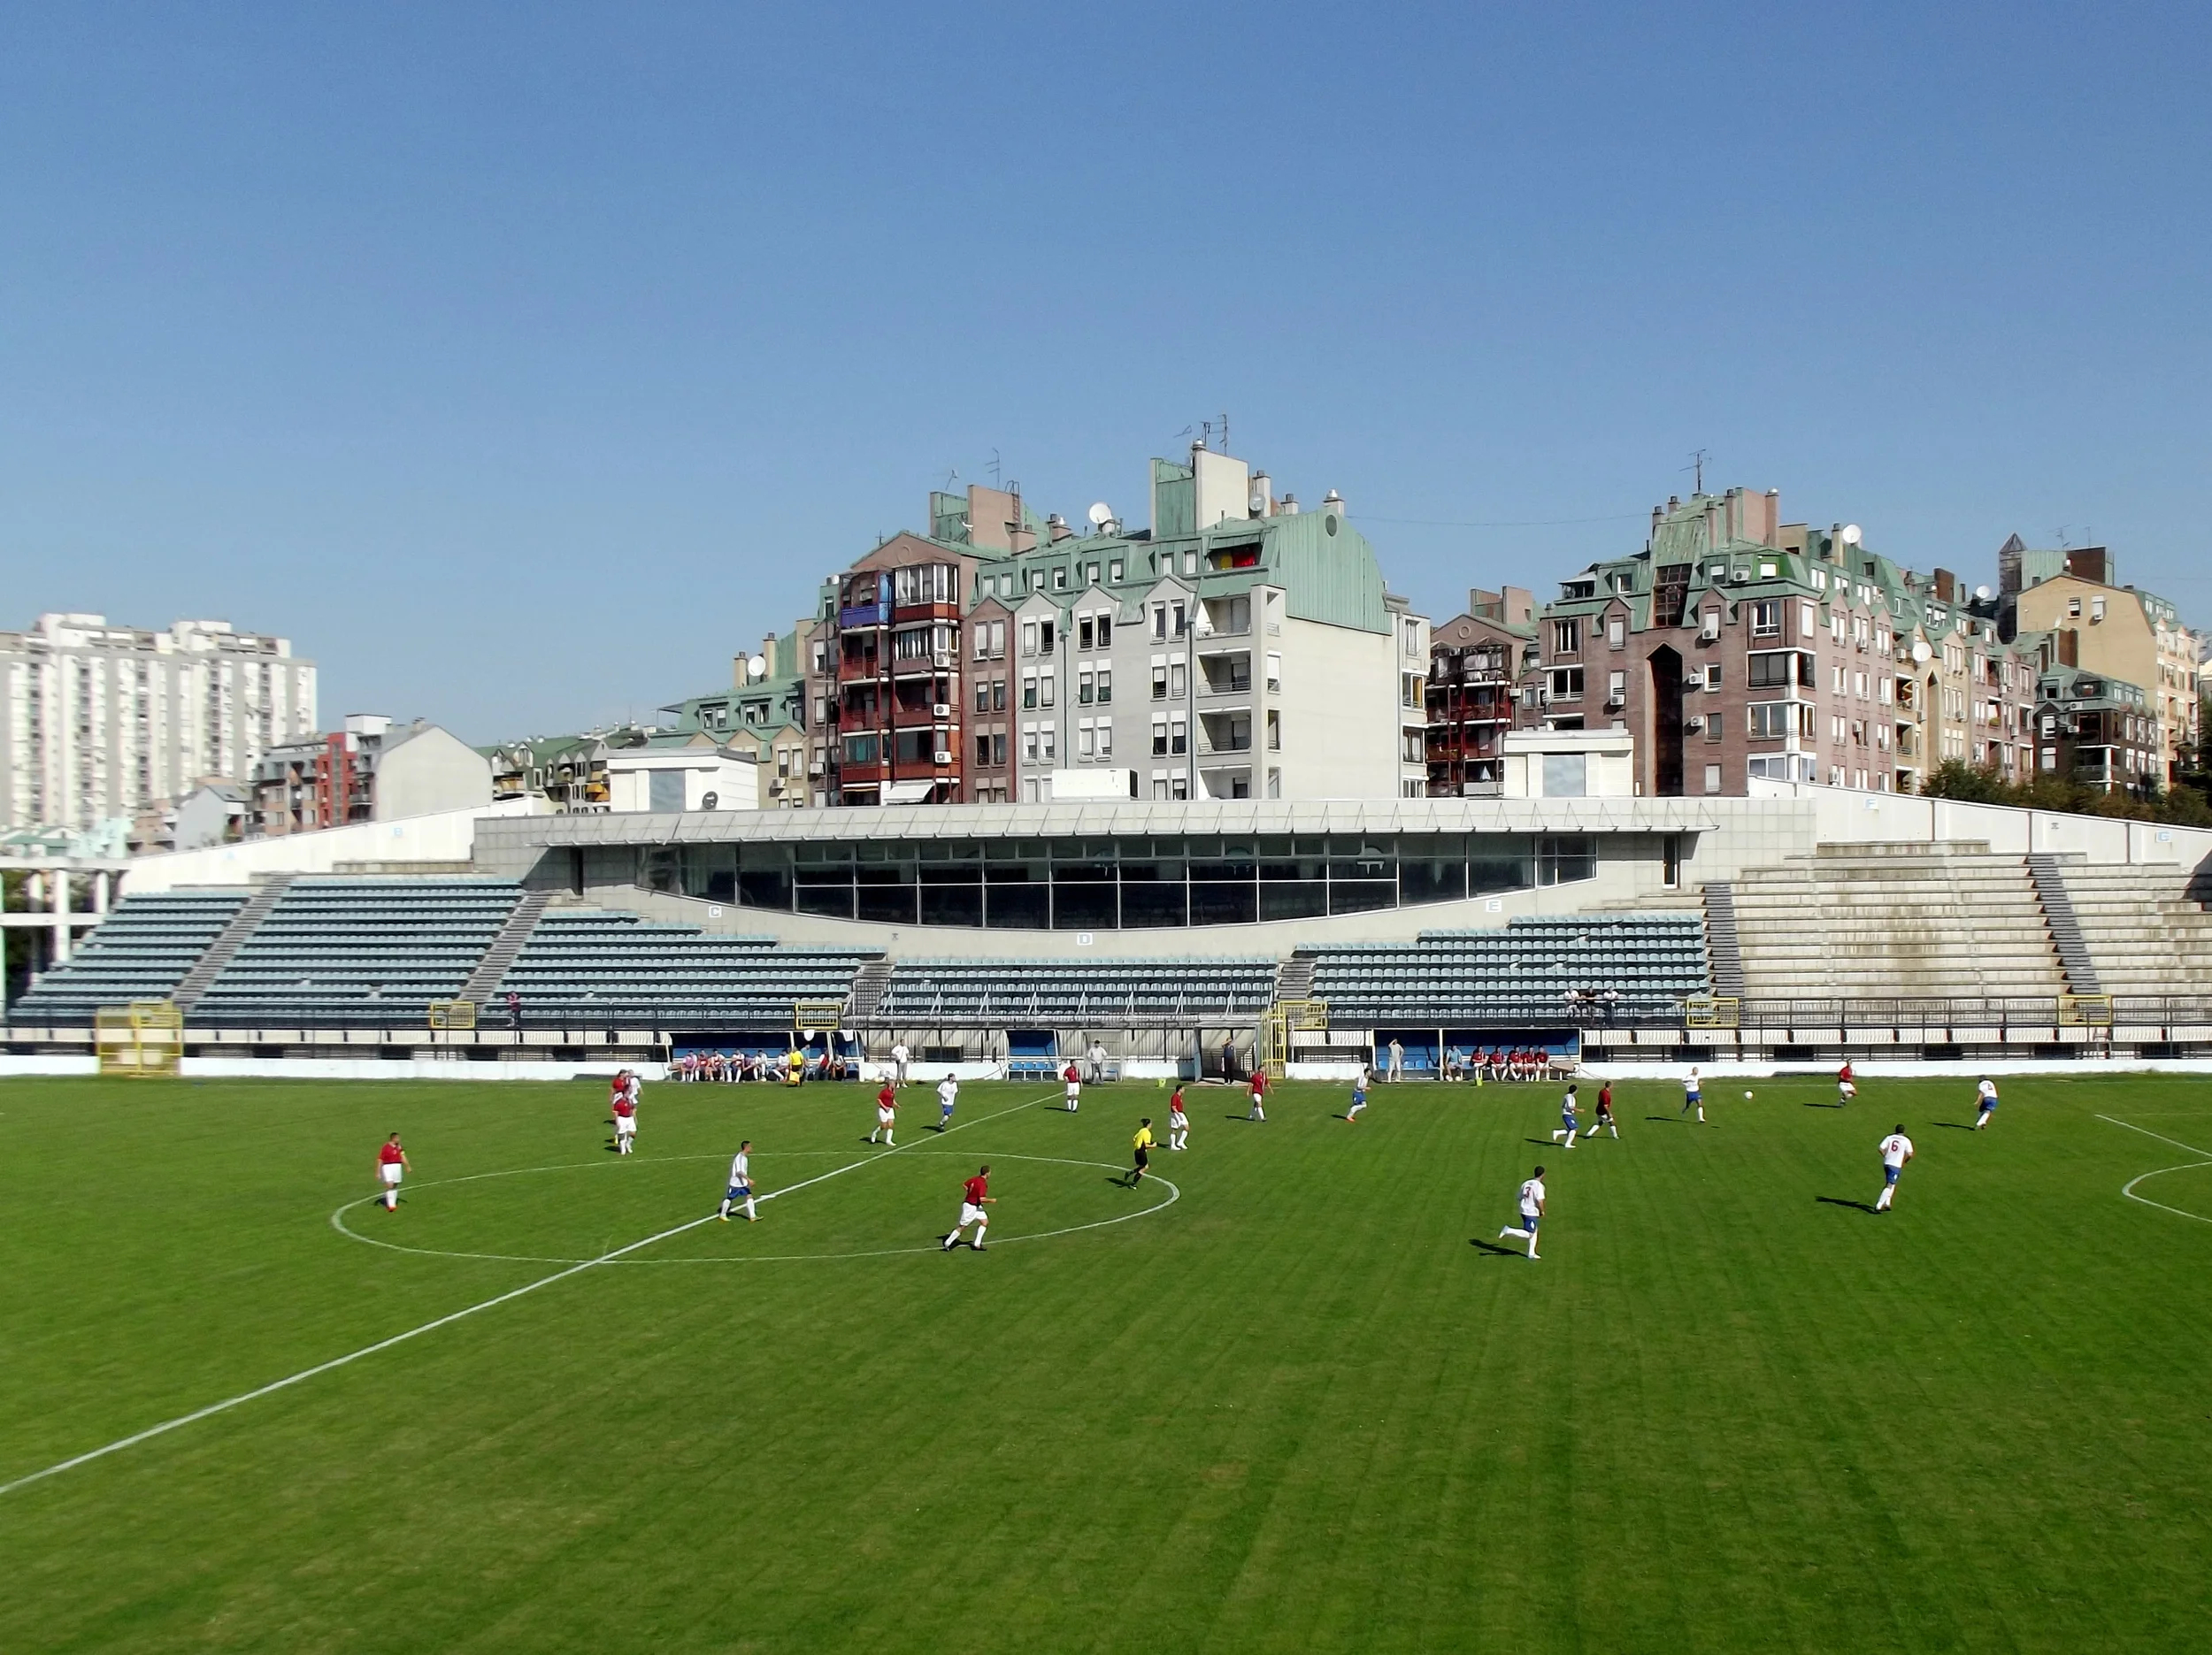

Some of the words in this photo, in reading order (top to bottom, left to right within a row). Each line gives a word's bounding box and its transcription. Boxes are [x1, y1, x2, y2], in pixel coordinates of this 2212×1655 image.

[1865, 799, 1876, 808] F
[395, 827, 403, 837] B
[1489, 900, 1500, 910] E
[710, 907, 720, 917] C
[1078, 934, 1090, 944] D
[1891, 1140, 1899, 1152] 6
[1525, 1186, 1532, 1198] 3
